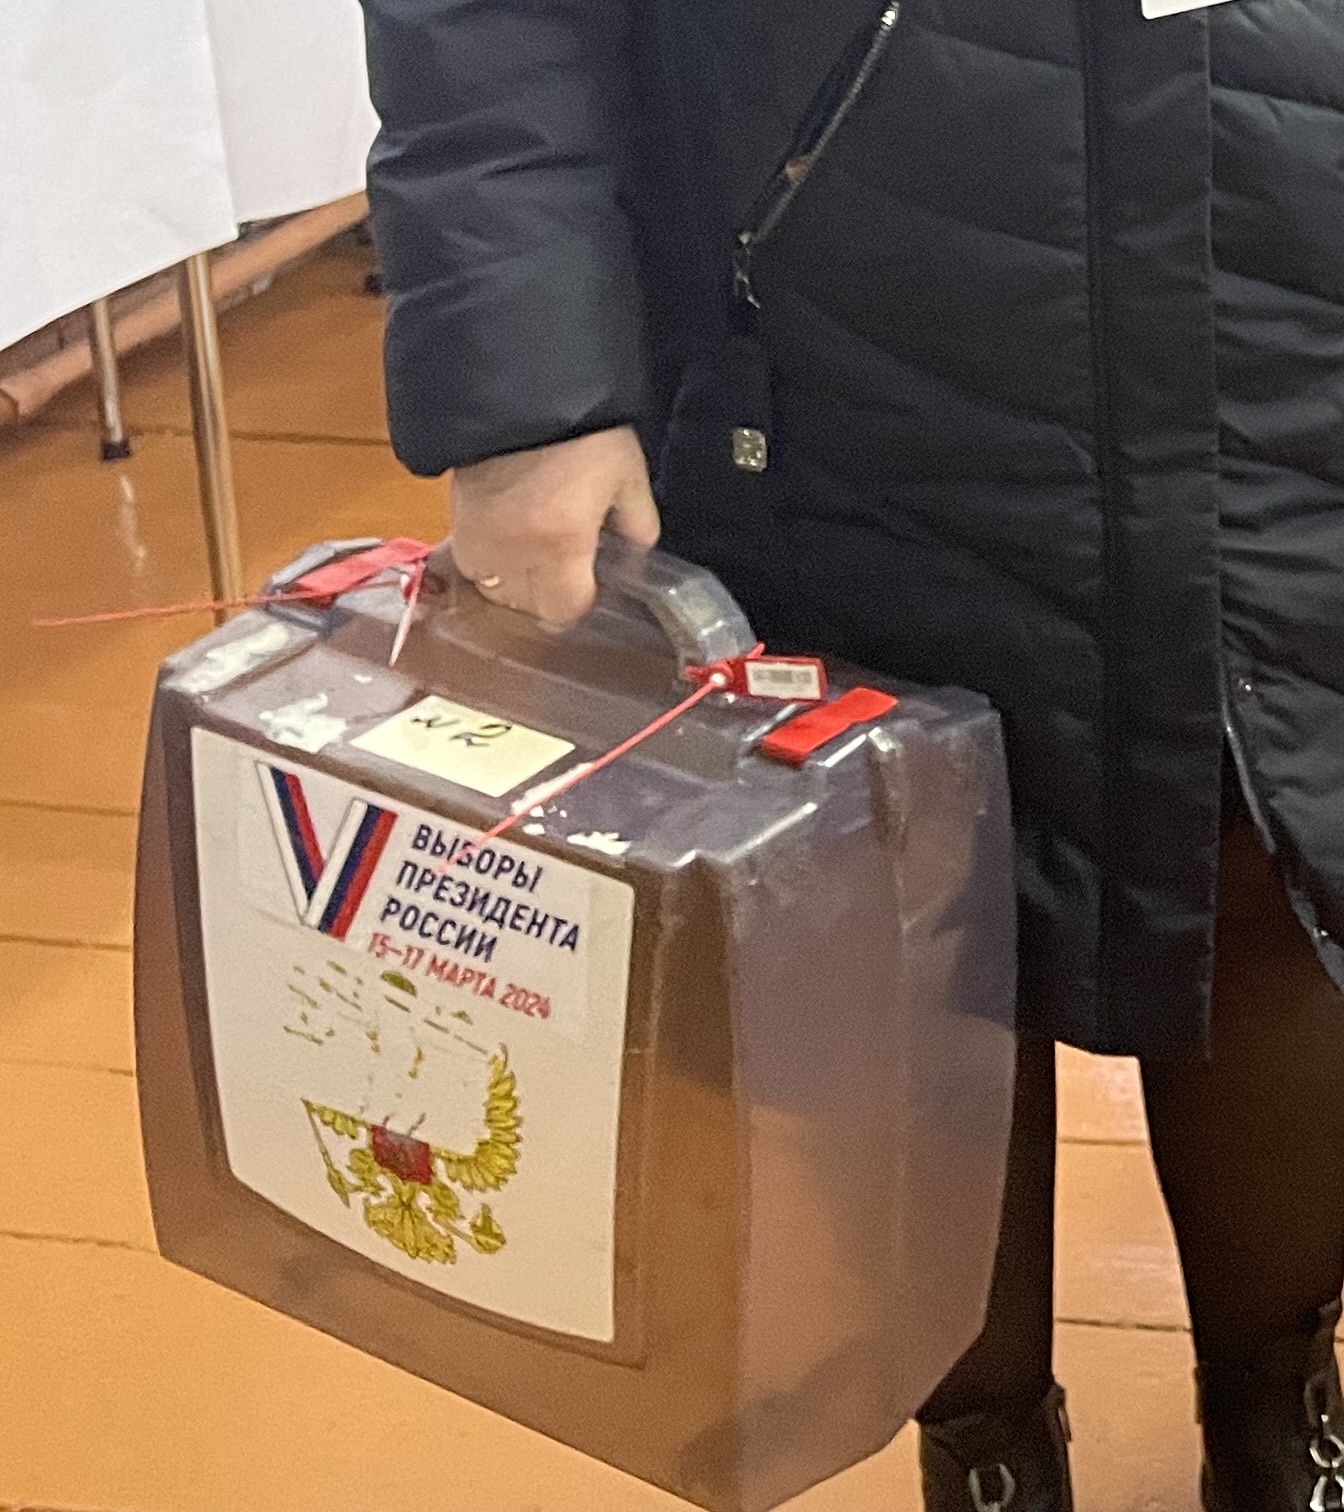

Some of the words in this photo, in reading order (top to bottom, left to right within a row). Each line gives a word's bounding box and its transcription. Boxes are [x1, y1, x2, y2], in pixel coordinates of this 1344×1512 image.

[411, 824, 543, 893] ВЫБОРЫ
[380, 894, 497, 963] РОССИИ
[396, 859, 581, 953] ПРЕЗИДЕНТА
[425, 954, 497, 998] МАРТА
[499, 982, 552, 1019] 2024
